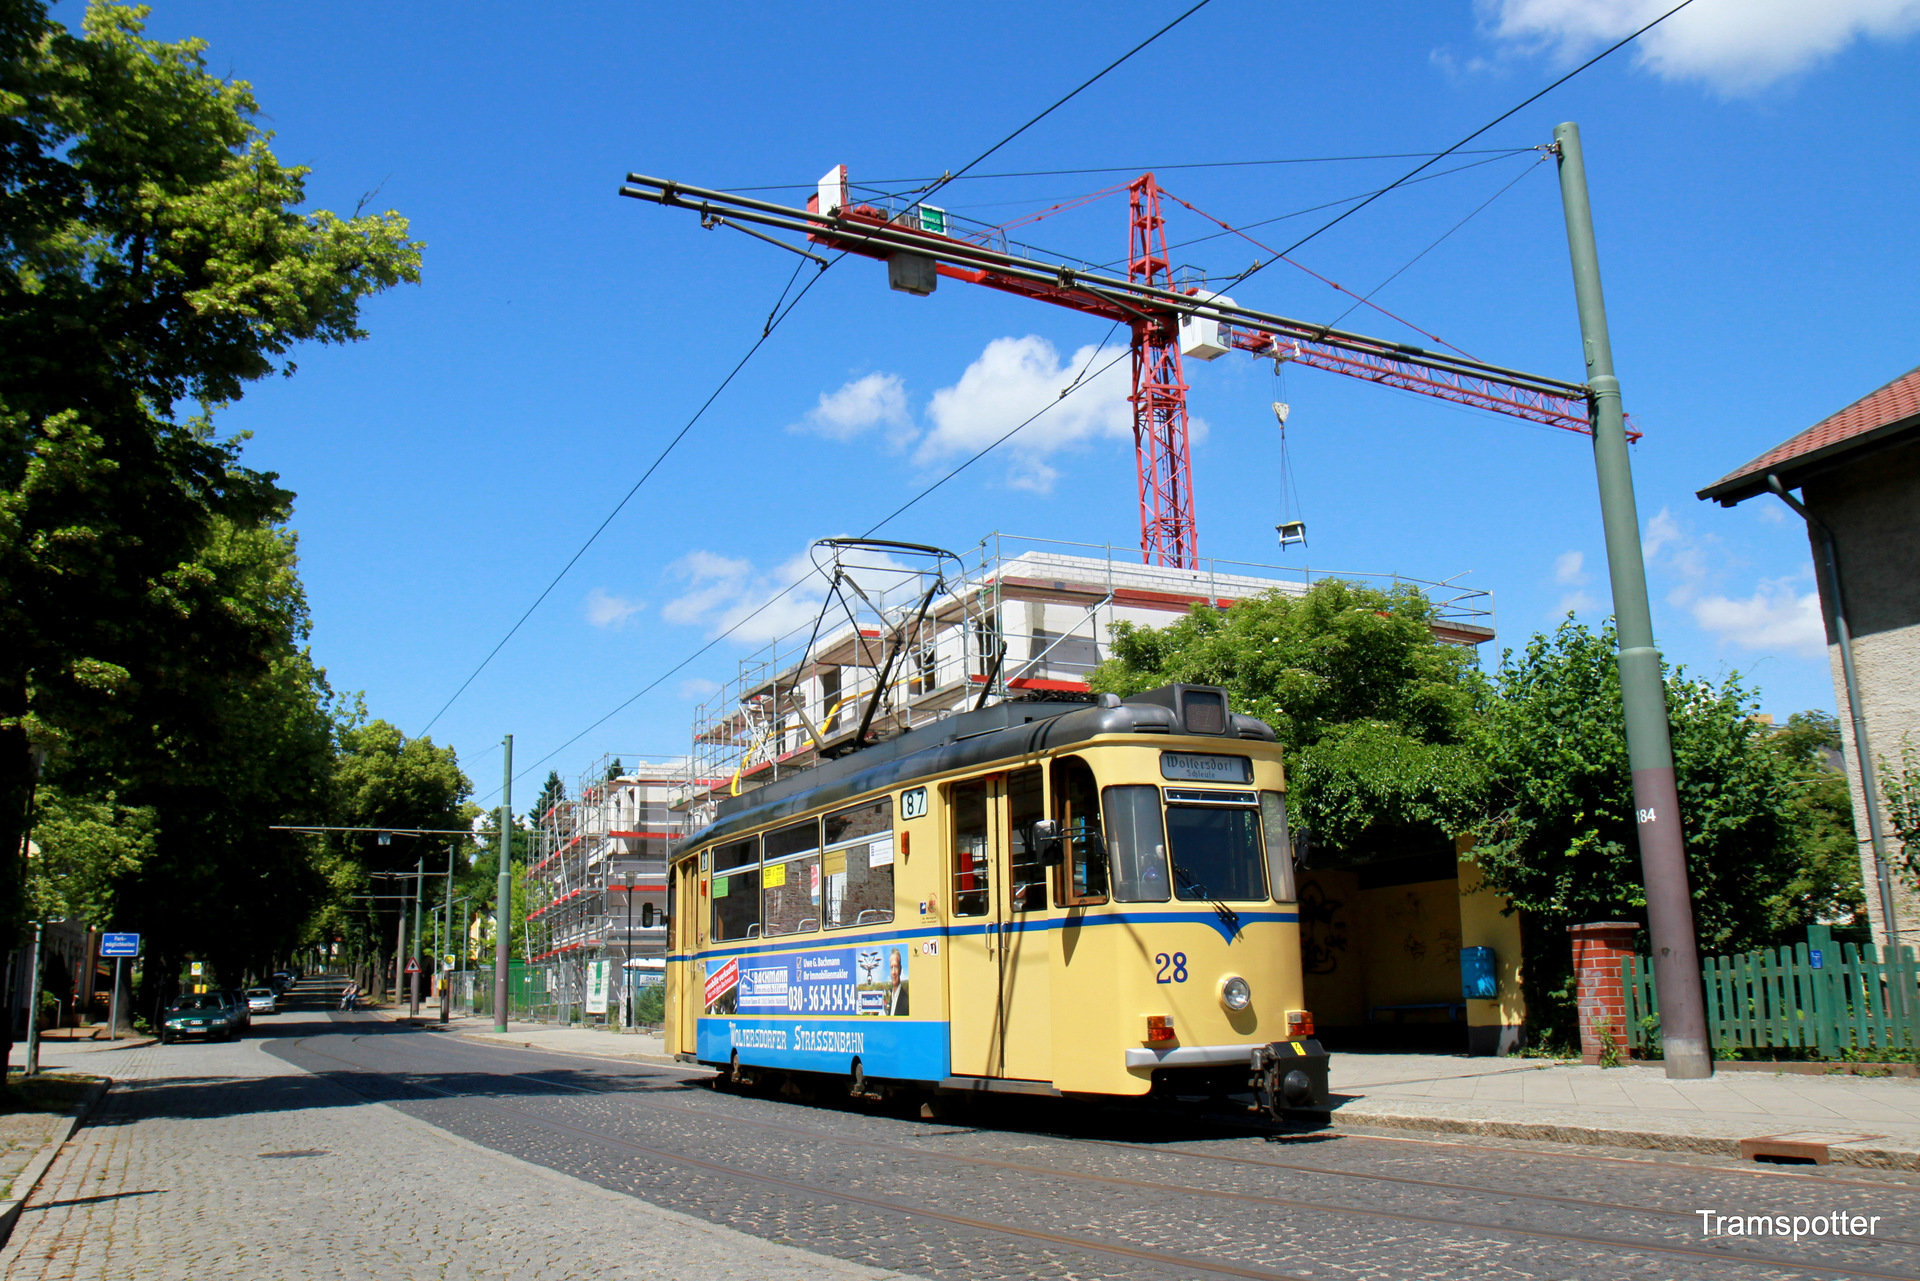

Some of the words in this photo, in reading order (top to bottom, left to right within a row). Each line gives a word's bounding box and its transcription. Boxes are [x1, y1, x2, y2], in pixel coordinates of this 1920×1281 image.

[907, 791, 924, 815] 87
[1636, 807, 1657, 823] 184
[803, 958, 812, 968] Uwe
[818, 956, 840, 967] Bachmann
[1155, 952, 1188, 984] 28
[753, 969, 788, 984] BACHMANN
[754, 984, 787, 993] Immobilien
[788, 986, 803, 1011] 030
[808, 985, 819, 1011] 56
[820, 985, 831, 1011] 54
[832, 984, 843, 1011] 54
[844, 984, 856, 1011] 54
[729, 1021, 787, 1050] WOLTERSDORFER
[793, 1024, 864, 1053] STRASSENBAHN
